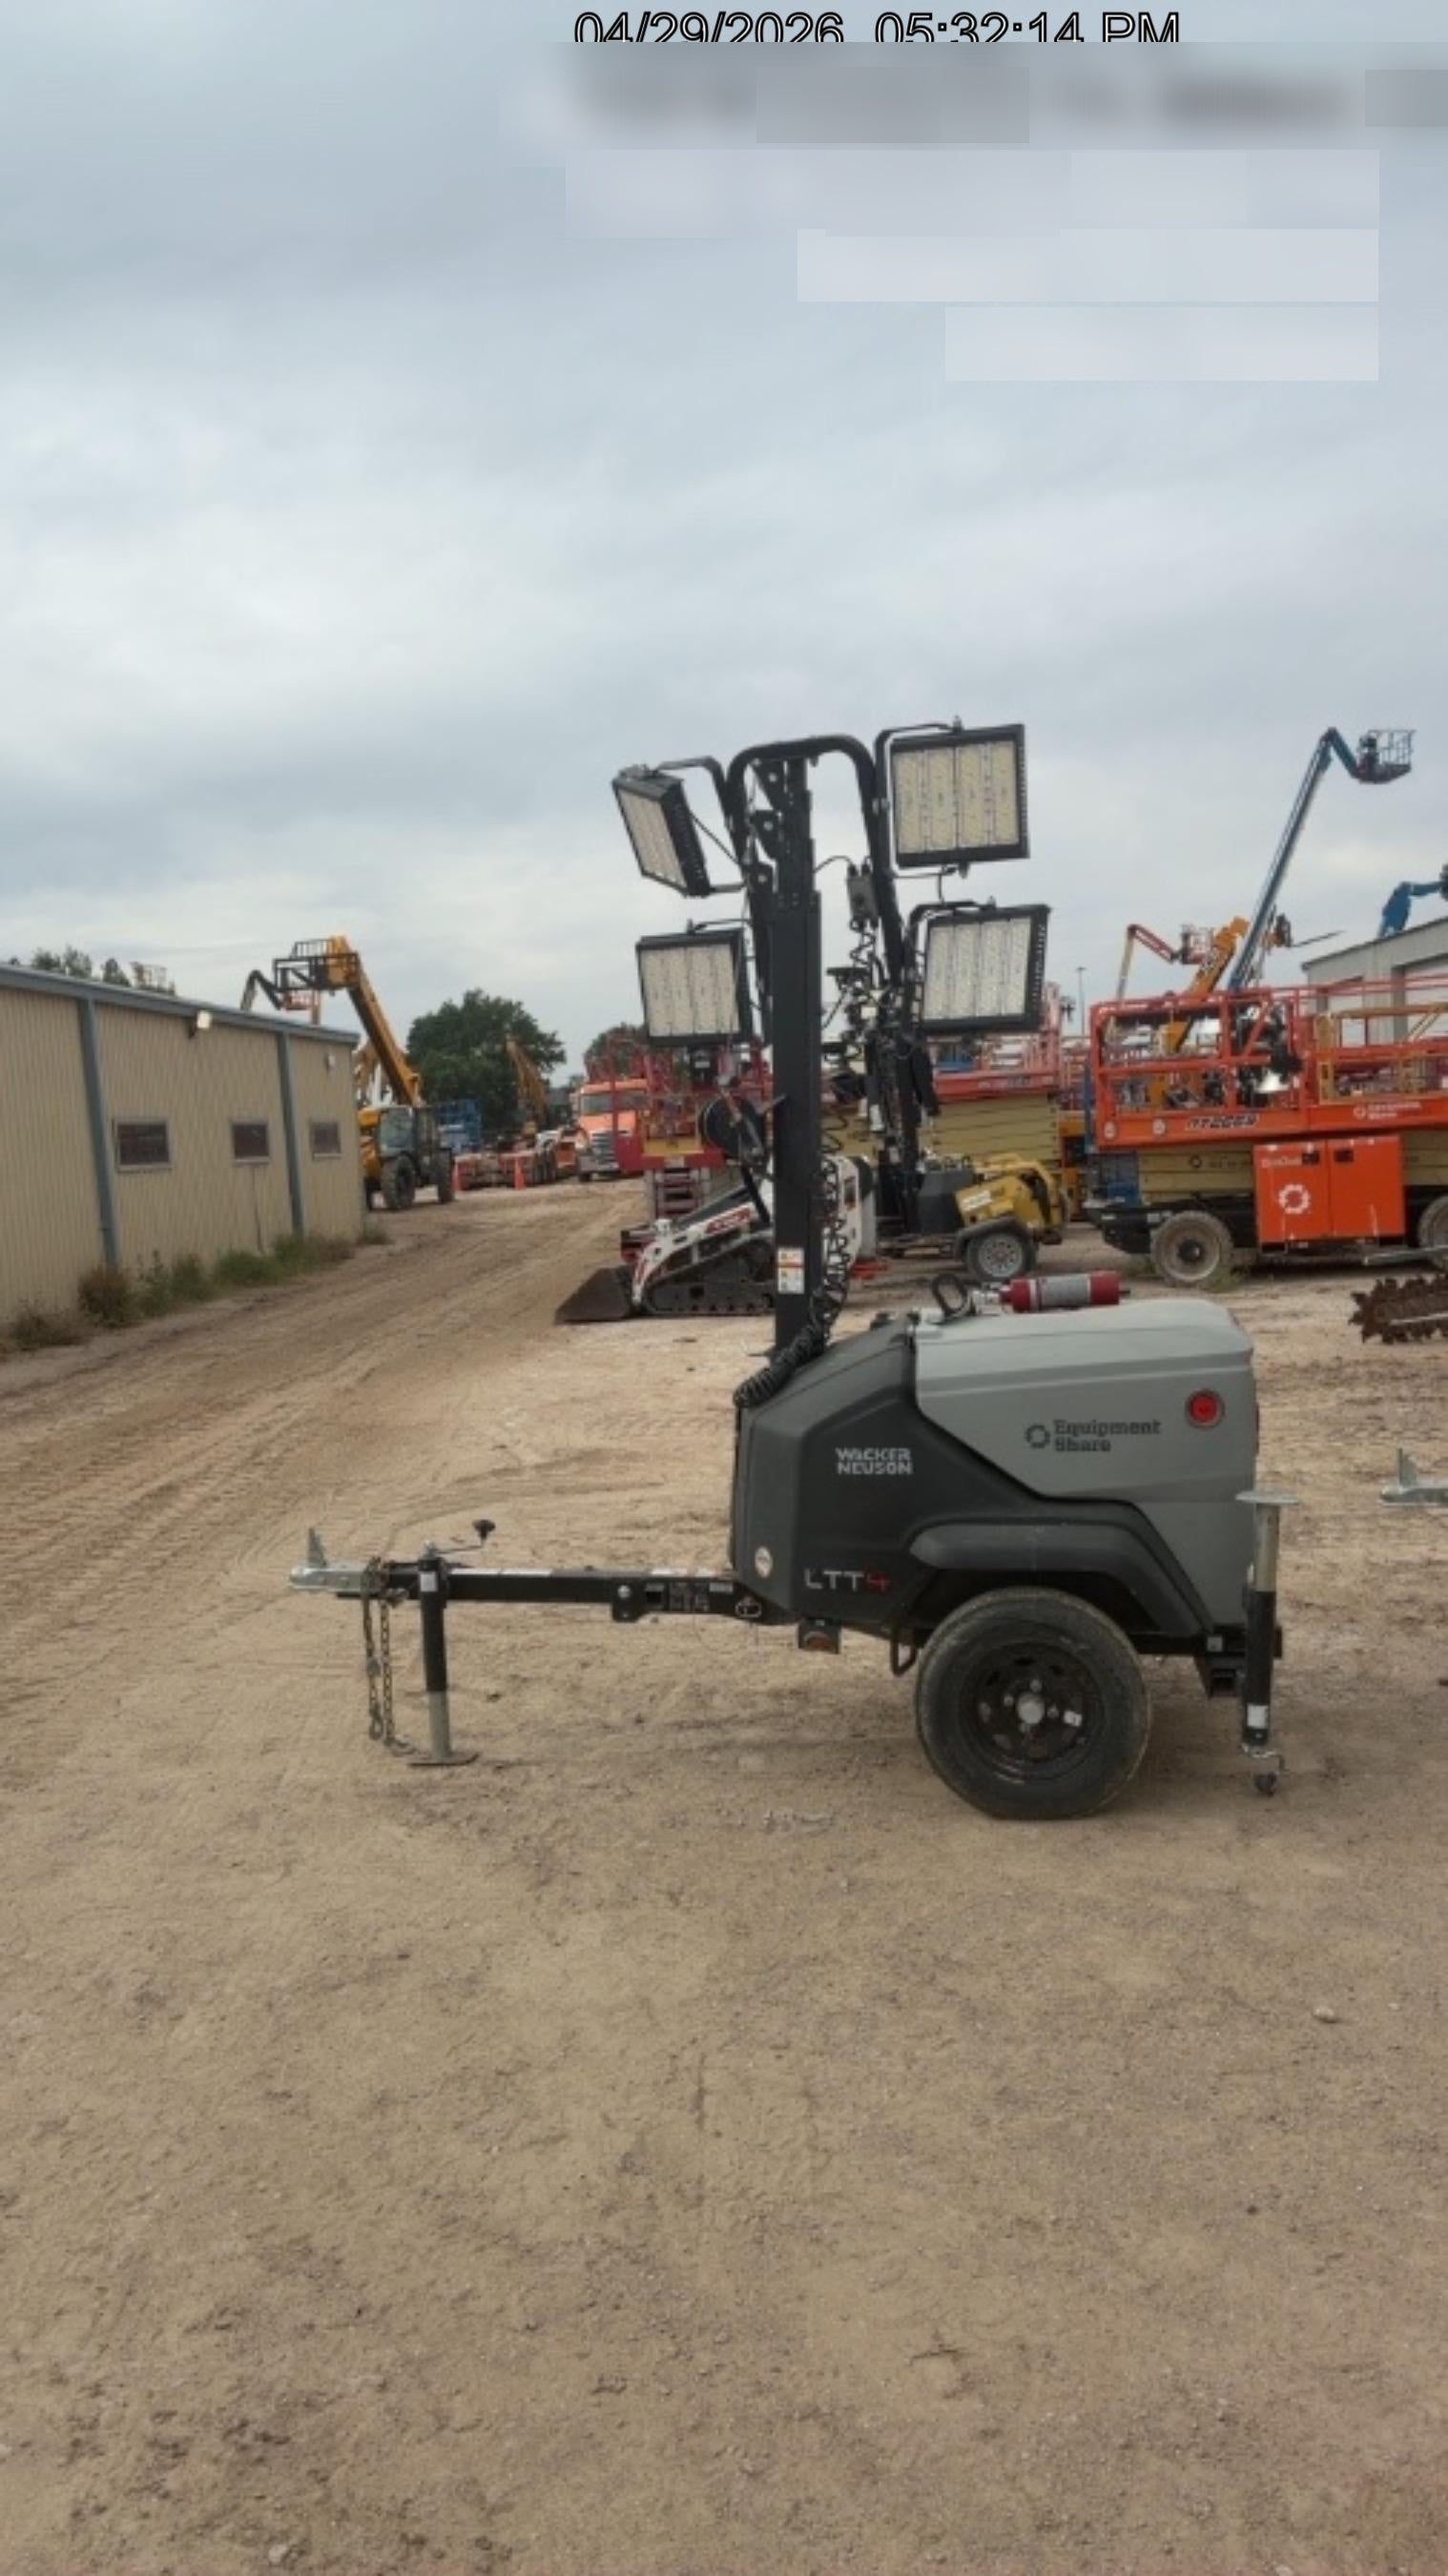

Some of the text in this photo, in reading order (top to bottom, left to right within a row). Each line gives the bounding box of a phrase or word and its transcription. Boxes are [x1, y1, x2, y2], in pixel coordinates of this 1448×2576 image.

[1053, 1419, 1162, 1438] Equipment
[1054, 1436, 1112, 1452] Share
[835, 1447, 912, 1461] WACKER
[838, 1461, 914, 1475] NEUSON
